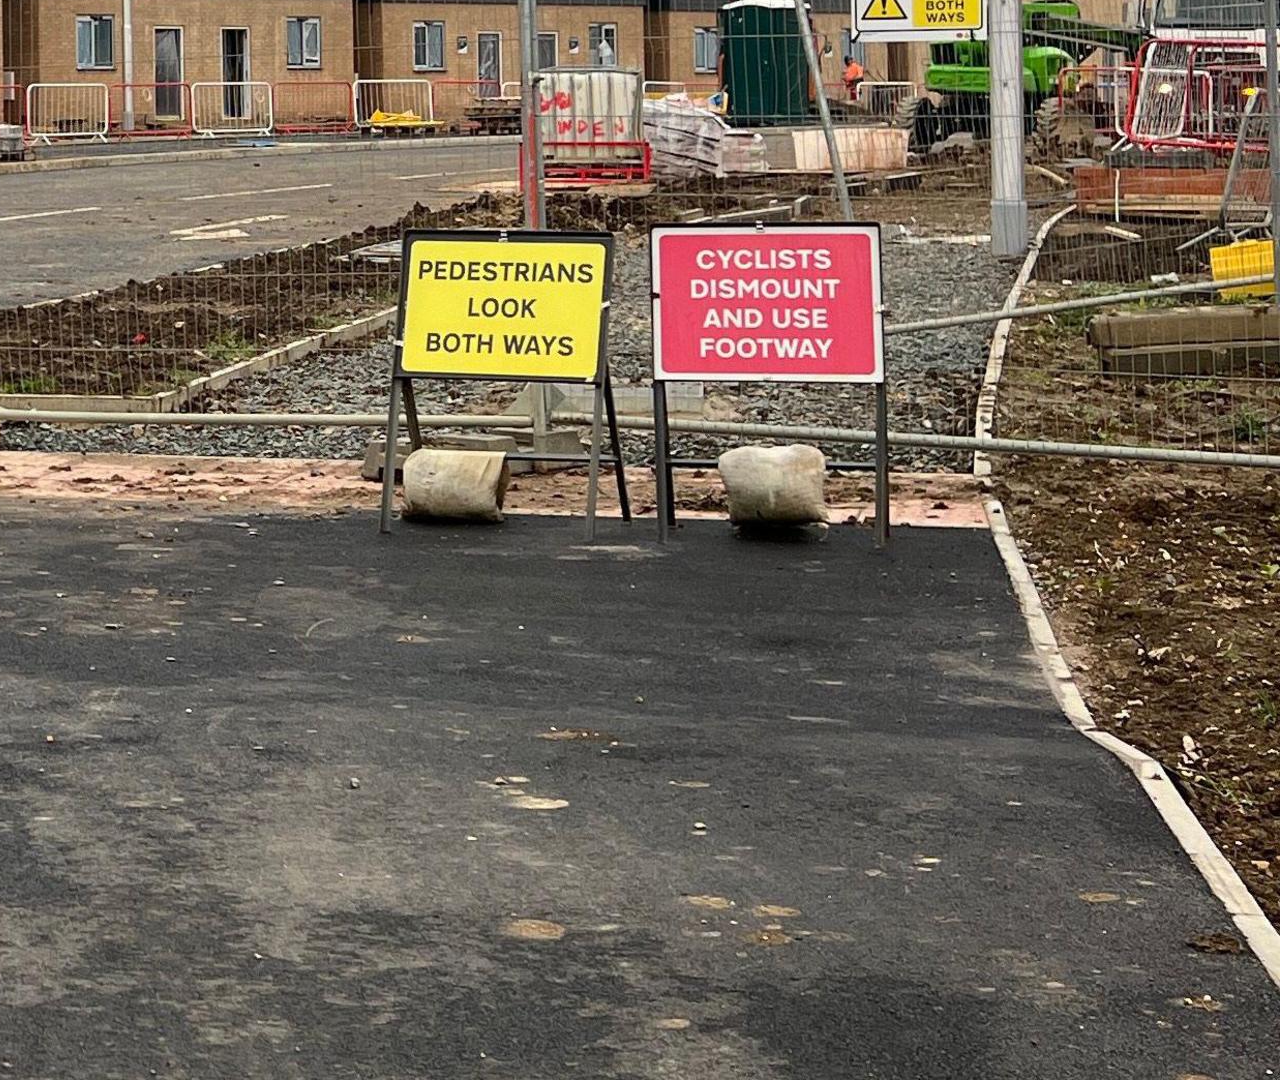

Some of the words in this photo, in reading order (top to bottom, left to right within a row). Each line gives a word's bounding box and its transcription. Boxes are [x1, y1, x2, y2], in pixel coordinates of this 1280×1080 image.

[926, 0, 965, 11] BOTH
[926, 12, 965, 23] WAYS
[695, 249, 832, 270] CYCLISTS
[418, 260, 593, 283] PEDESTRIANS
[690, 278, 840, 299] DISMOUNT
[468, 298, 536, 318] LOOK
[703, 308, 764, 328] AND
[772, 308, 828, 329] USE
[426, 333, 493, 354] BOTH
[503, 335, 574, 356] WAYS
[699, 338, 833, 358] FOOTWAY
